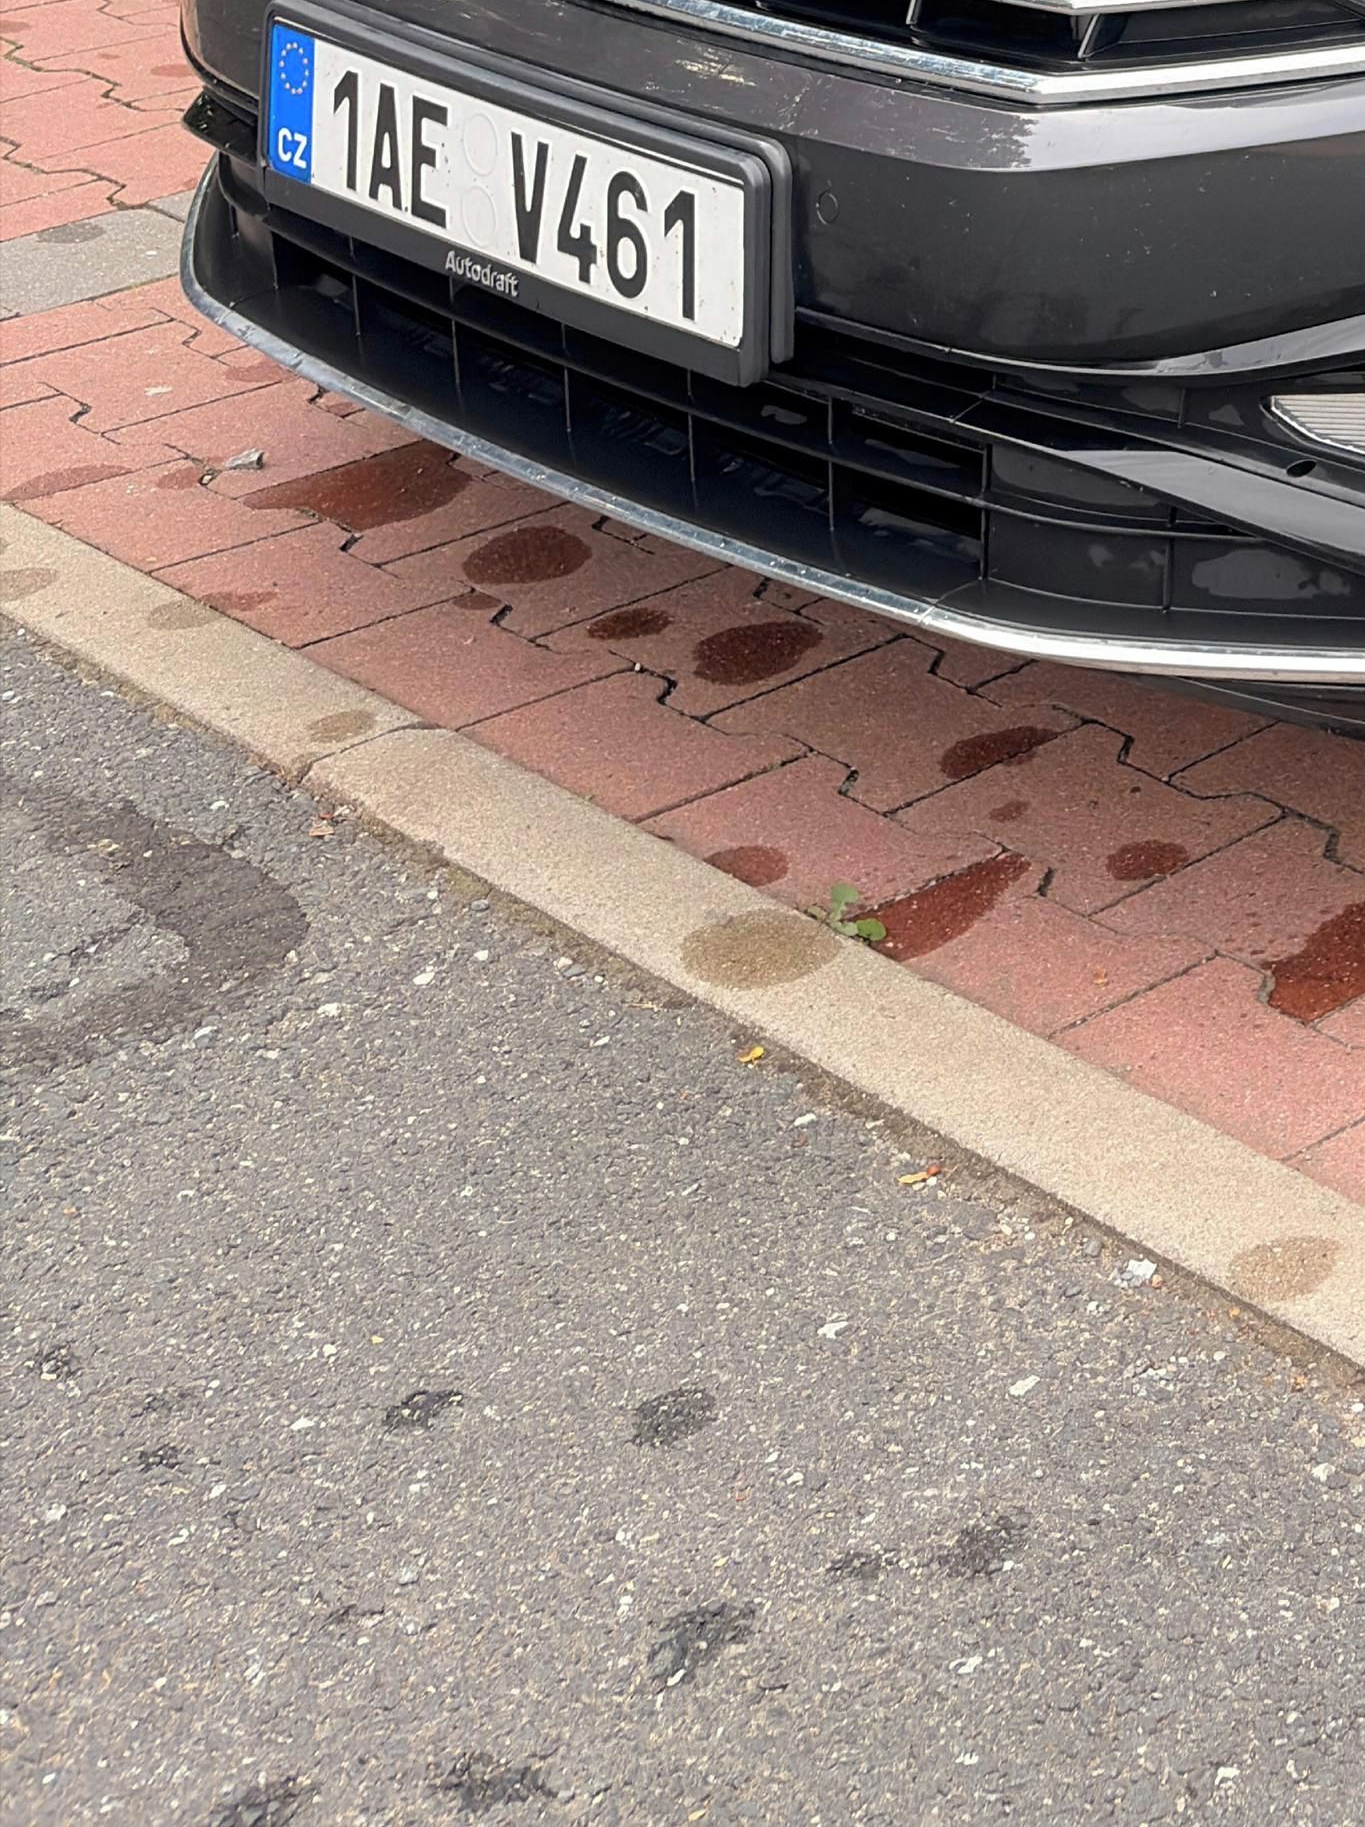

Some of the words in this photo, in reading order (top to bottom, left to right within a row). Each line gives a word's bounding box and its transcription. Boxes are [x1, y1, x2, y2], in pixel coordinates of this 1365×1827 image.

[276, 126, 308, 170] CZ
[332, 69, 450, 230] 1AE
[510, 130, 697, 322] V461
[444, 249, 519, 298] Autodraft
